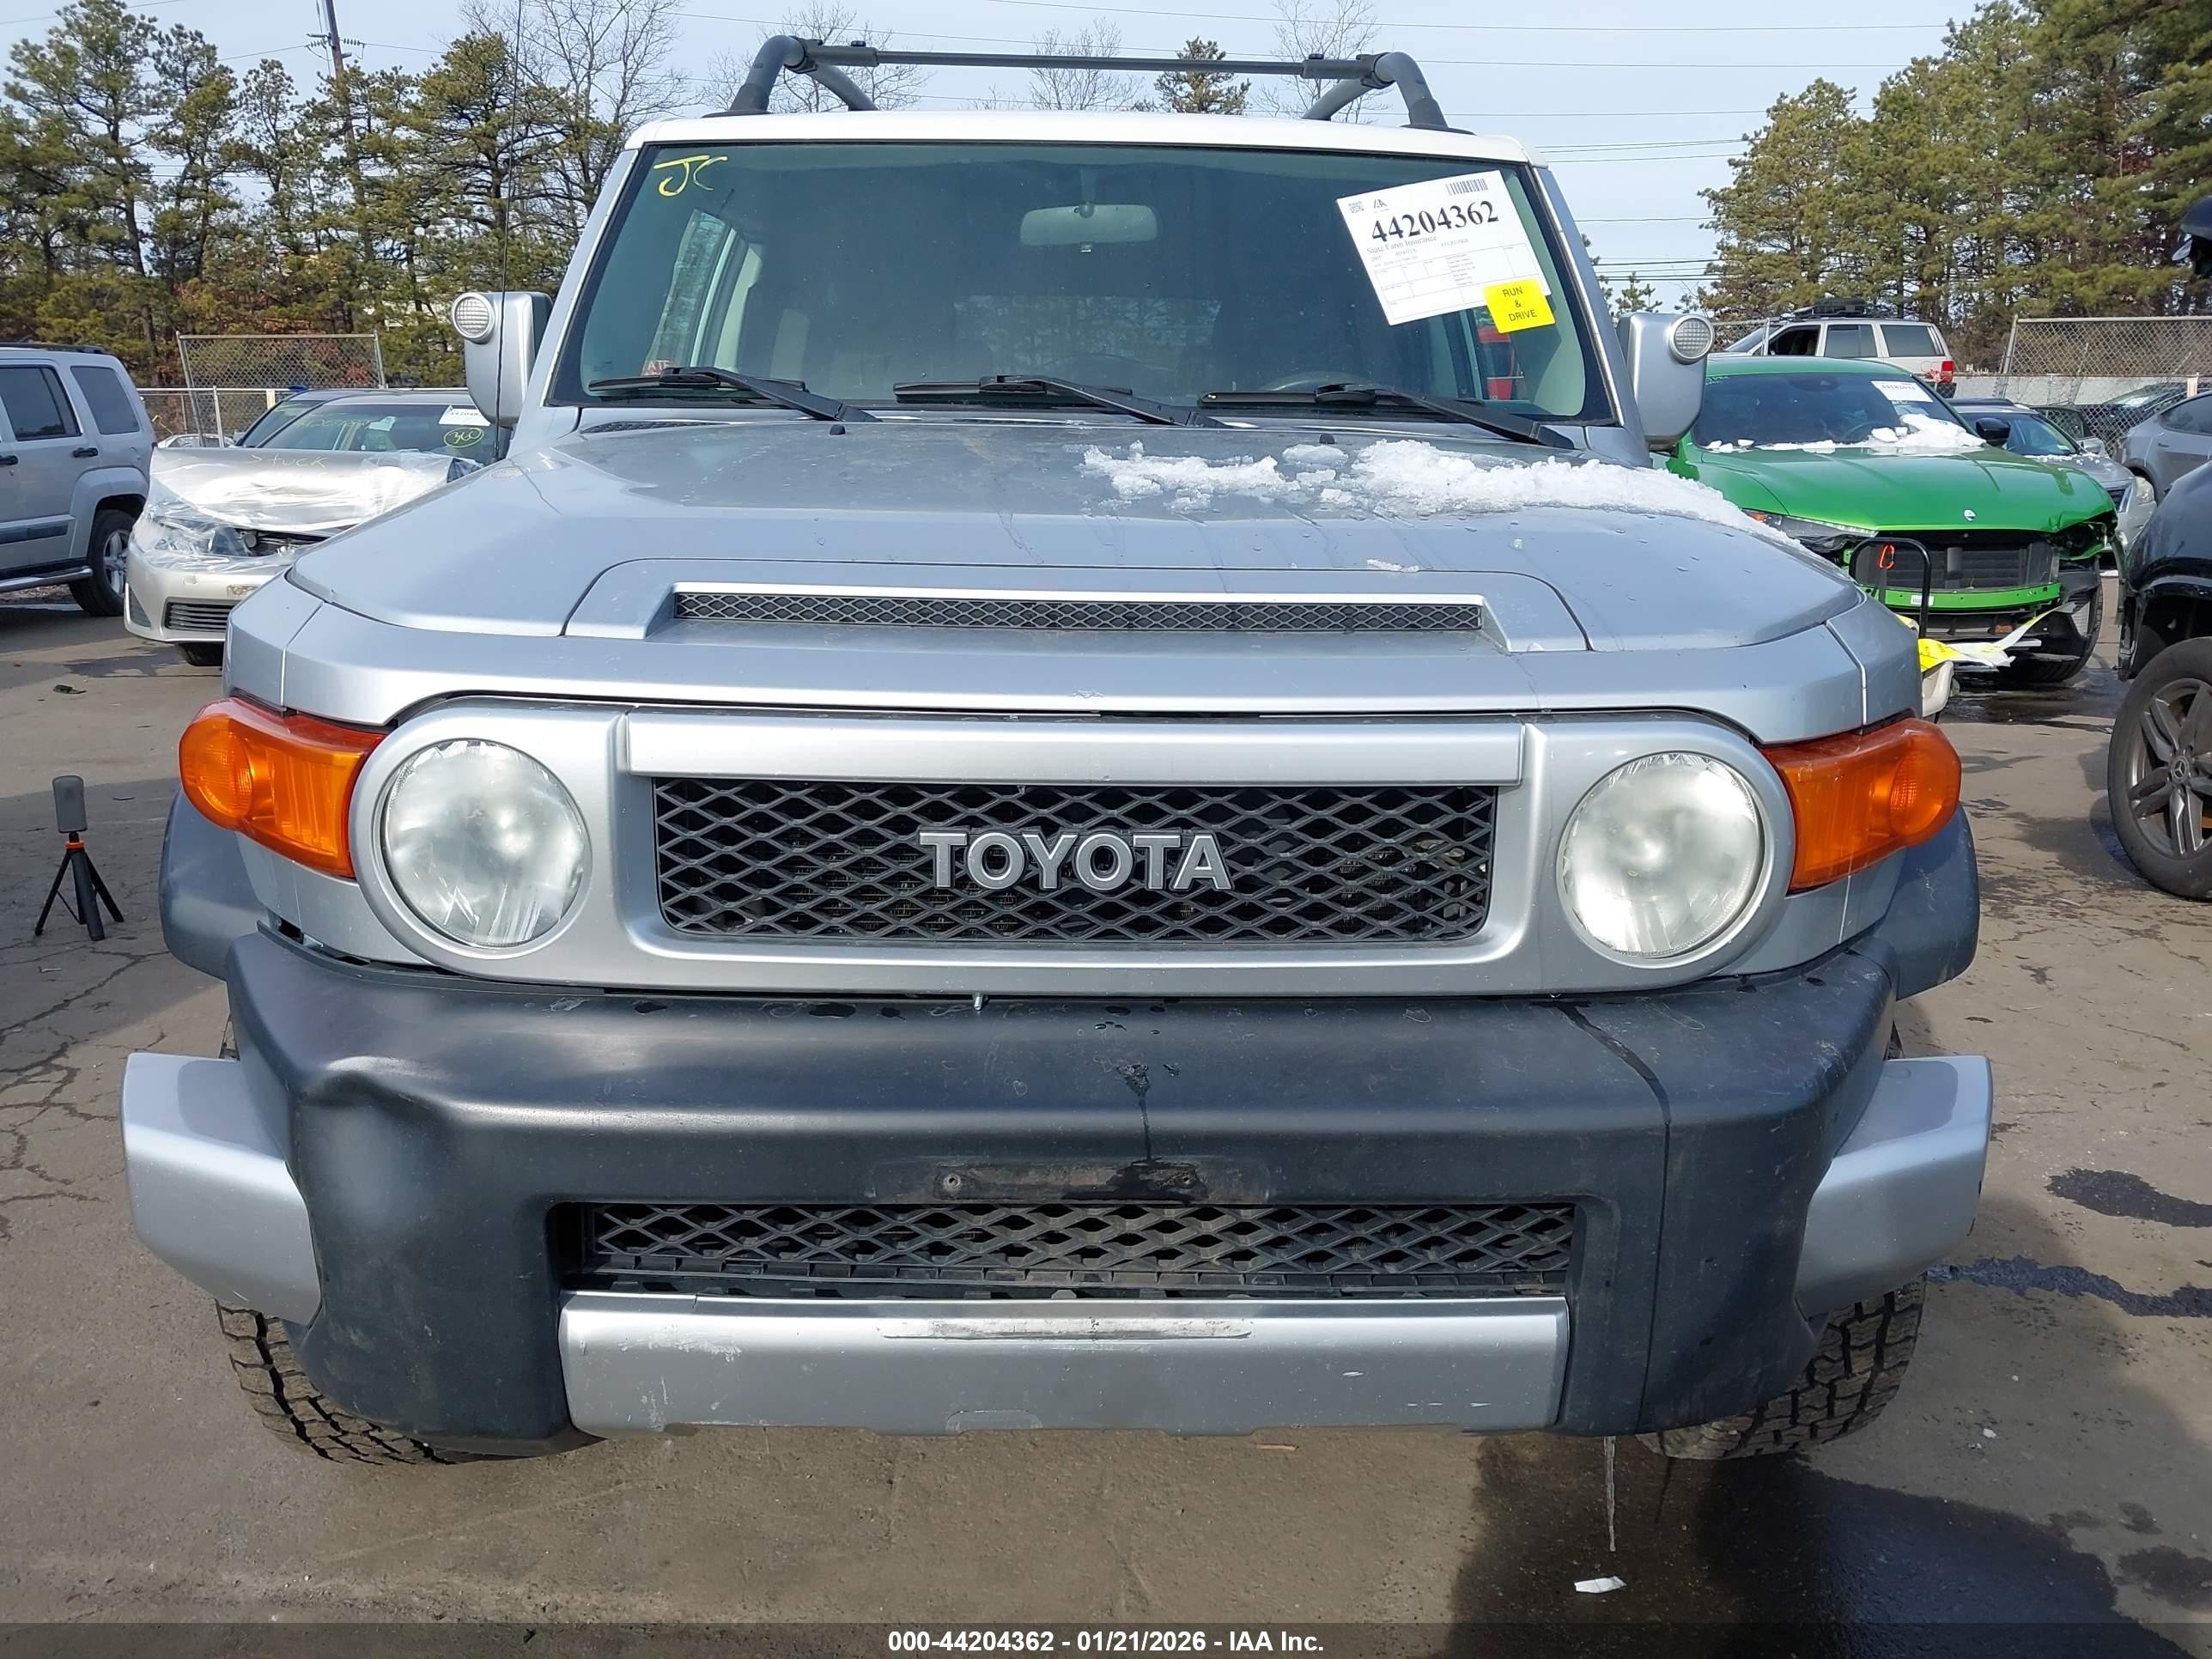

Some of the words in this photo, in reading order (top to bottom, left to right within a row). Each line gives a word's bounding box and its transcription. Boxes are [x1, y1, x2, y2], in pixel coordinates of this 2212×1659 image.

[653, 155, 727, 197] JC
[1371, 201, 1499, 242] 44204362
[1502, 286, 1523, 297] RUN
[1508, 309, 1538, 322] DRIVE
[919, 831, 1232, 890] TOYOTA
